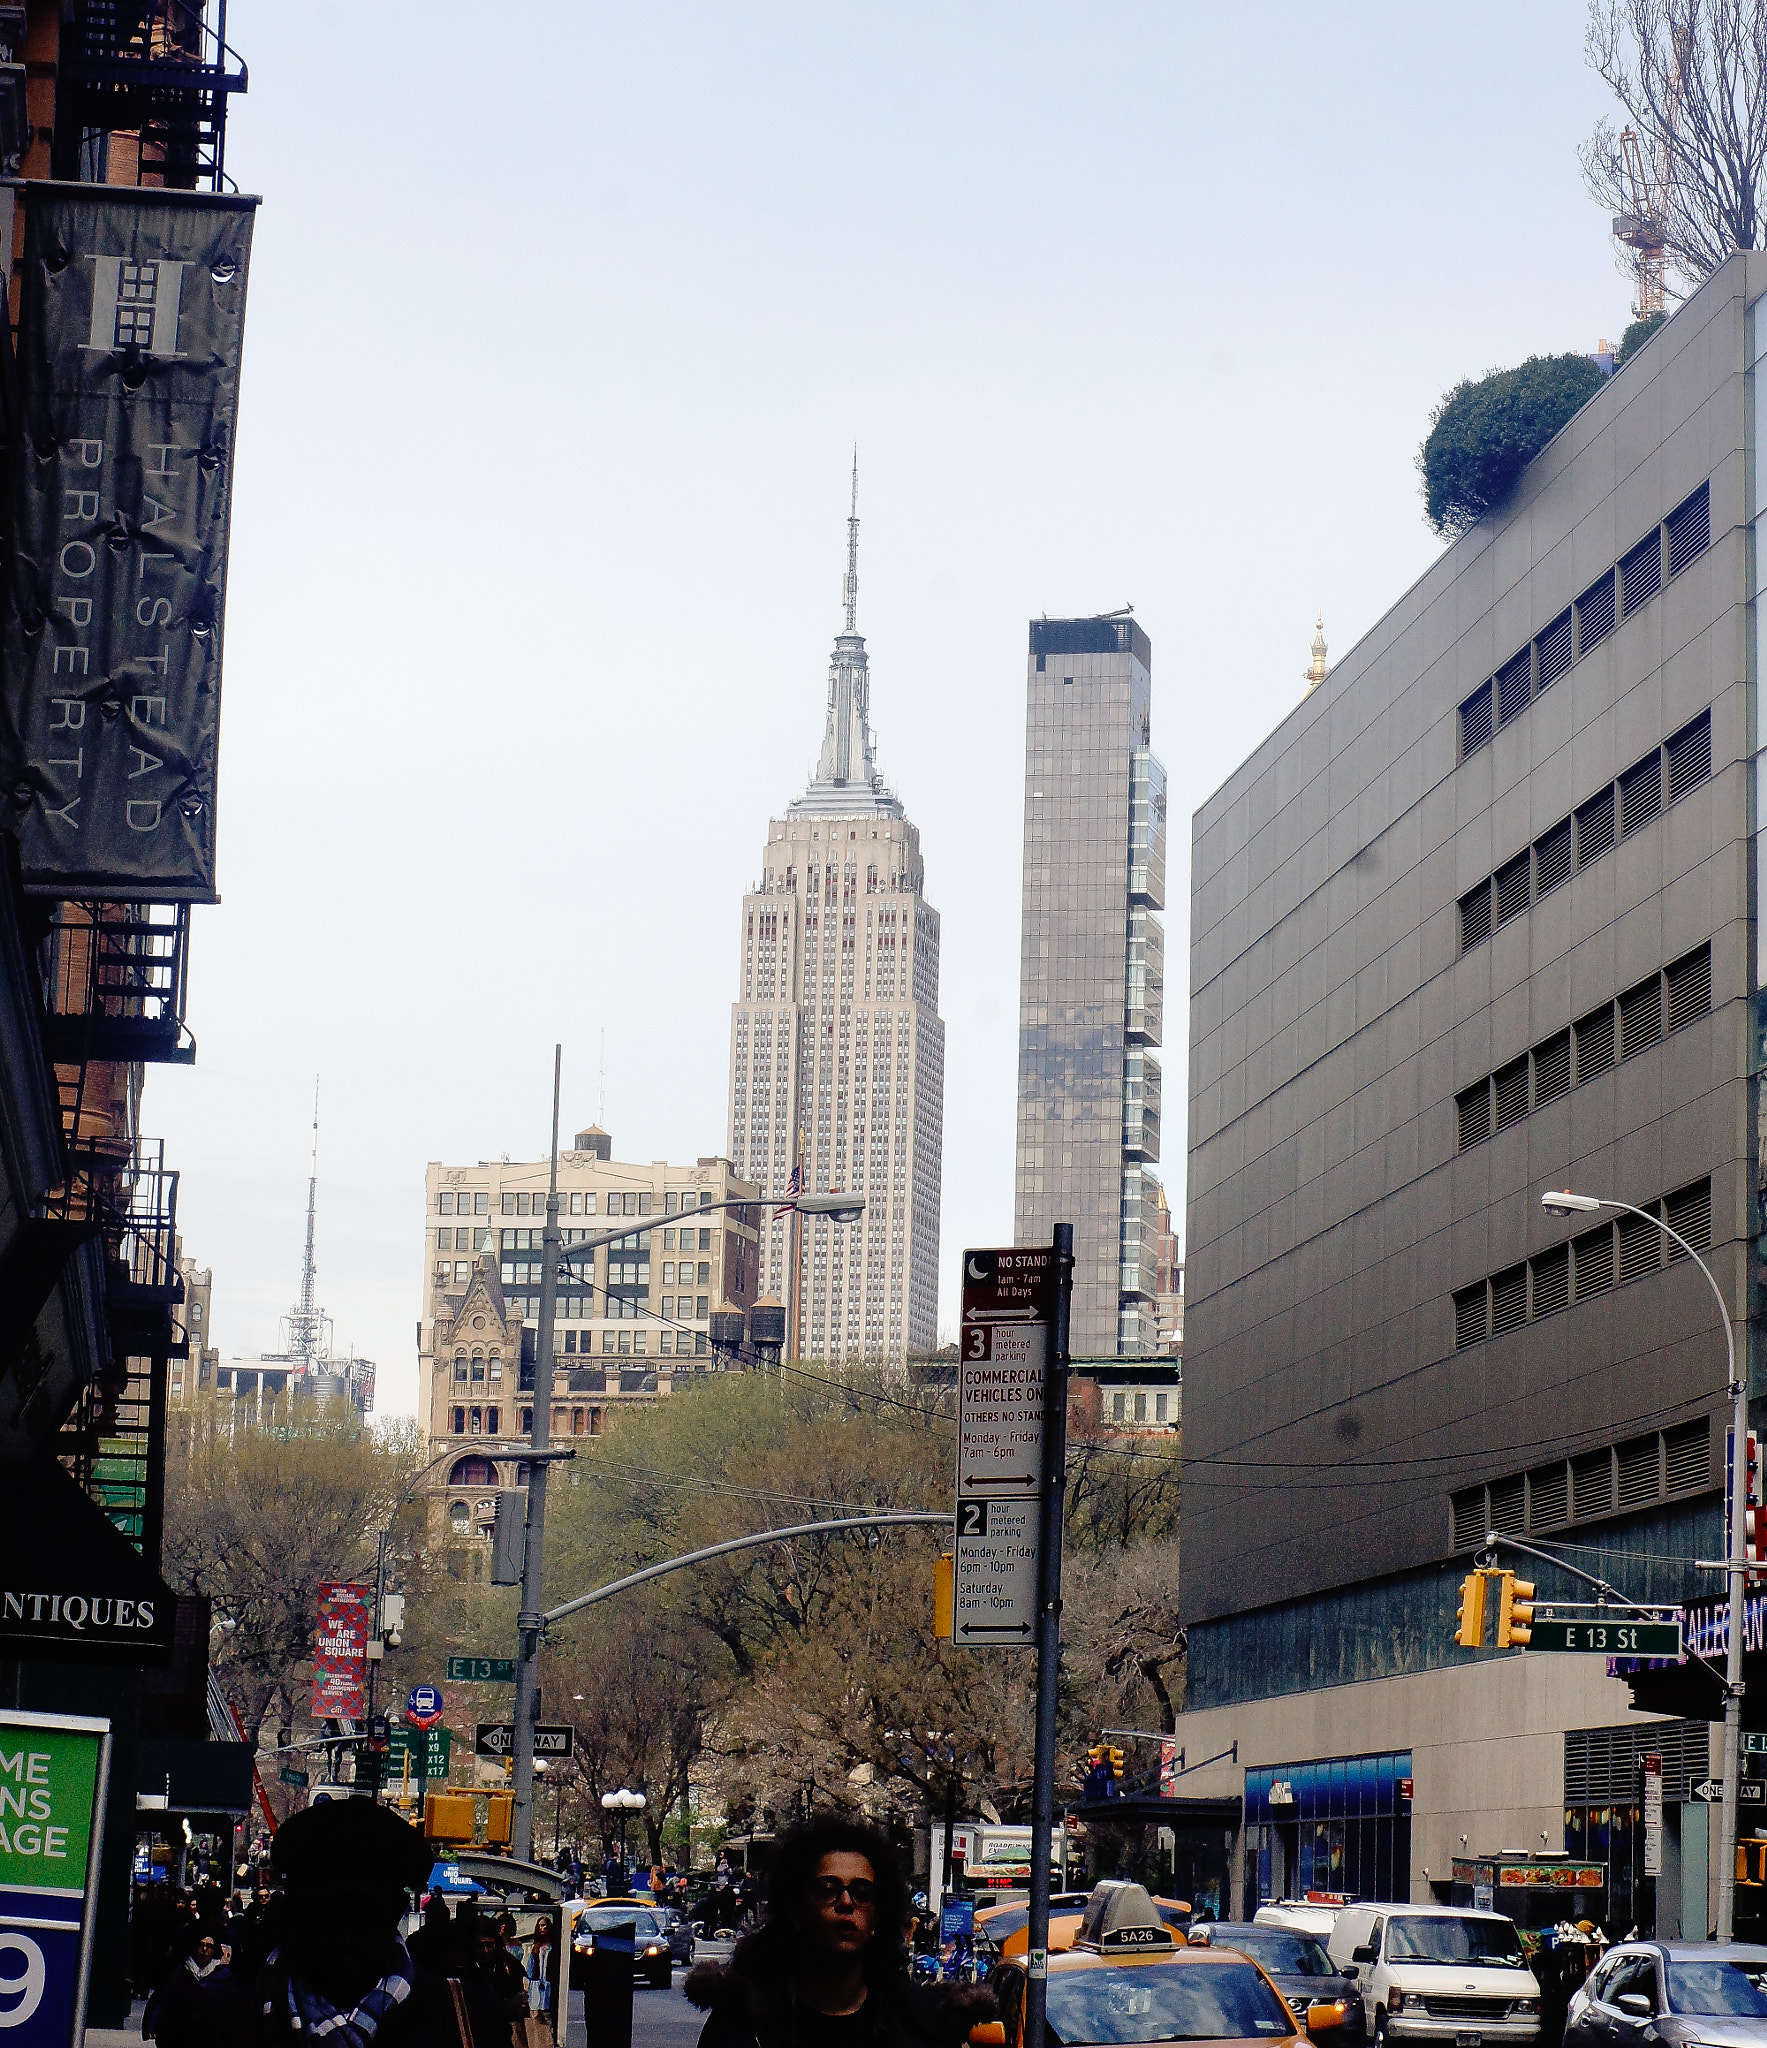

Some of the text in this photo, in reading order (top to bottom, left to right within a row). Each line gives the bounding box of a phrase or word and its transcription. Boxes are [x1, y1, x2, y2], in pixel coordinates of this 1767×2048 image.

[44, 437, 104, 830] PROPERTY
[124, 441, 184, 832] HALSTEAD
[998, 1256, 1012, 1268] NO
[1023, 1274, 1041, 1284] 7am
[997, 1287, 1032, 1298] All Days
[996, 1329, 1014, 1337] hour
[968, 1328, 985, 1359] 3
[996, 1340, 1031, 1349] metered
[995, 1351, 1026, 1362] parking
[965, 1369, 1044, 1385] COMMERCIAL
[966, 1386, 1044, 1403] VEHICLES ON
[964, 1410, 1046, 1423] OTHERS NO STAND
[964, 1432, 1000, 1445] Monday
[1010, 1431, 1040, 1444] Friday
[964, 1447, 984, 1458] 7am
[994, 1447, 1014, 1459] 6pm
[991, 1504, 1010, 1513] hour
[964, 1504, 980, 1534] 2
[990, 1515, 1026, 1525] metered
[990, 1527, 1021, 1538] parking
[960, 1546, 998, 1559] Monday
[1006, 1546, 1037, 1559] Friday
[960, 1562, 980, 1574] 6pm
[990, 1561, 1015, 1574] 10pm
[960, 1582, 1003, 1595] Saturday
[960, 1598, 980, 1608] 8am
[990, 1597, 1014, 1609] 10pm
[2, 1592, 154, 1630] NTIQUES
[328, 1620, 344, 1629] WE
[336, 1630, 356, 1639] ARE
[1566, 1628, 1637, 1649] E 13 St
[318, 1638, 349, 1647] UNION
[325, 1647, 364, 1658] SQUARE
[452, 1659, 510, 1678] E 13 ST
[1748, 1736, 1756, 1749] E
[1702, 1785, 1756, 1797] ONE AY
[0, 1786, 51, 1820] NS
[1120, 1930, 1153, 1942] 5A26
